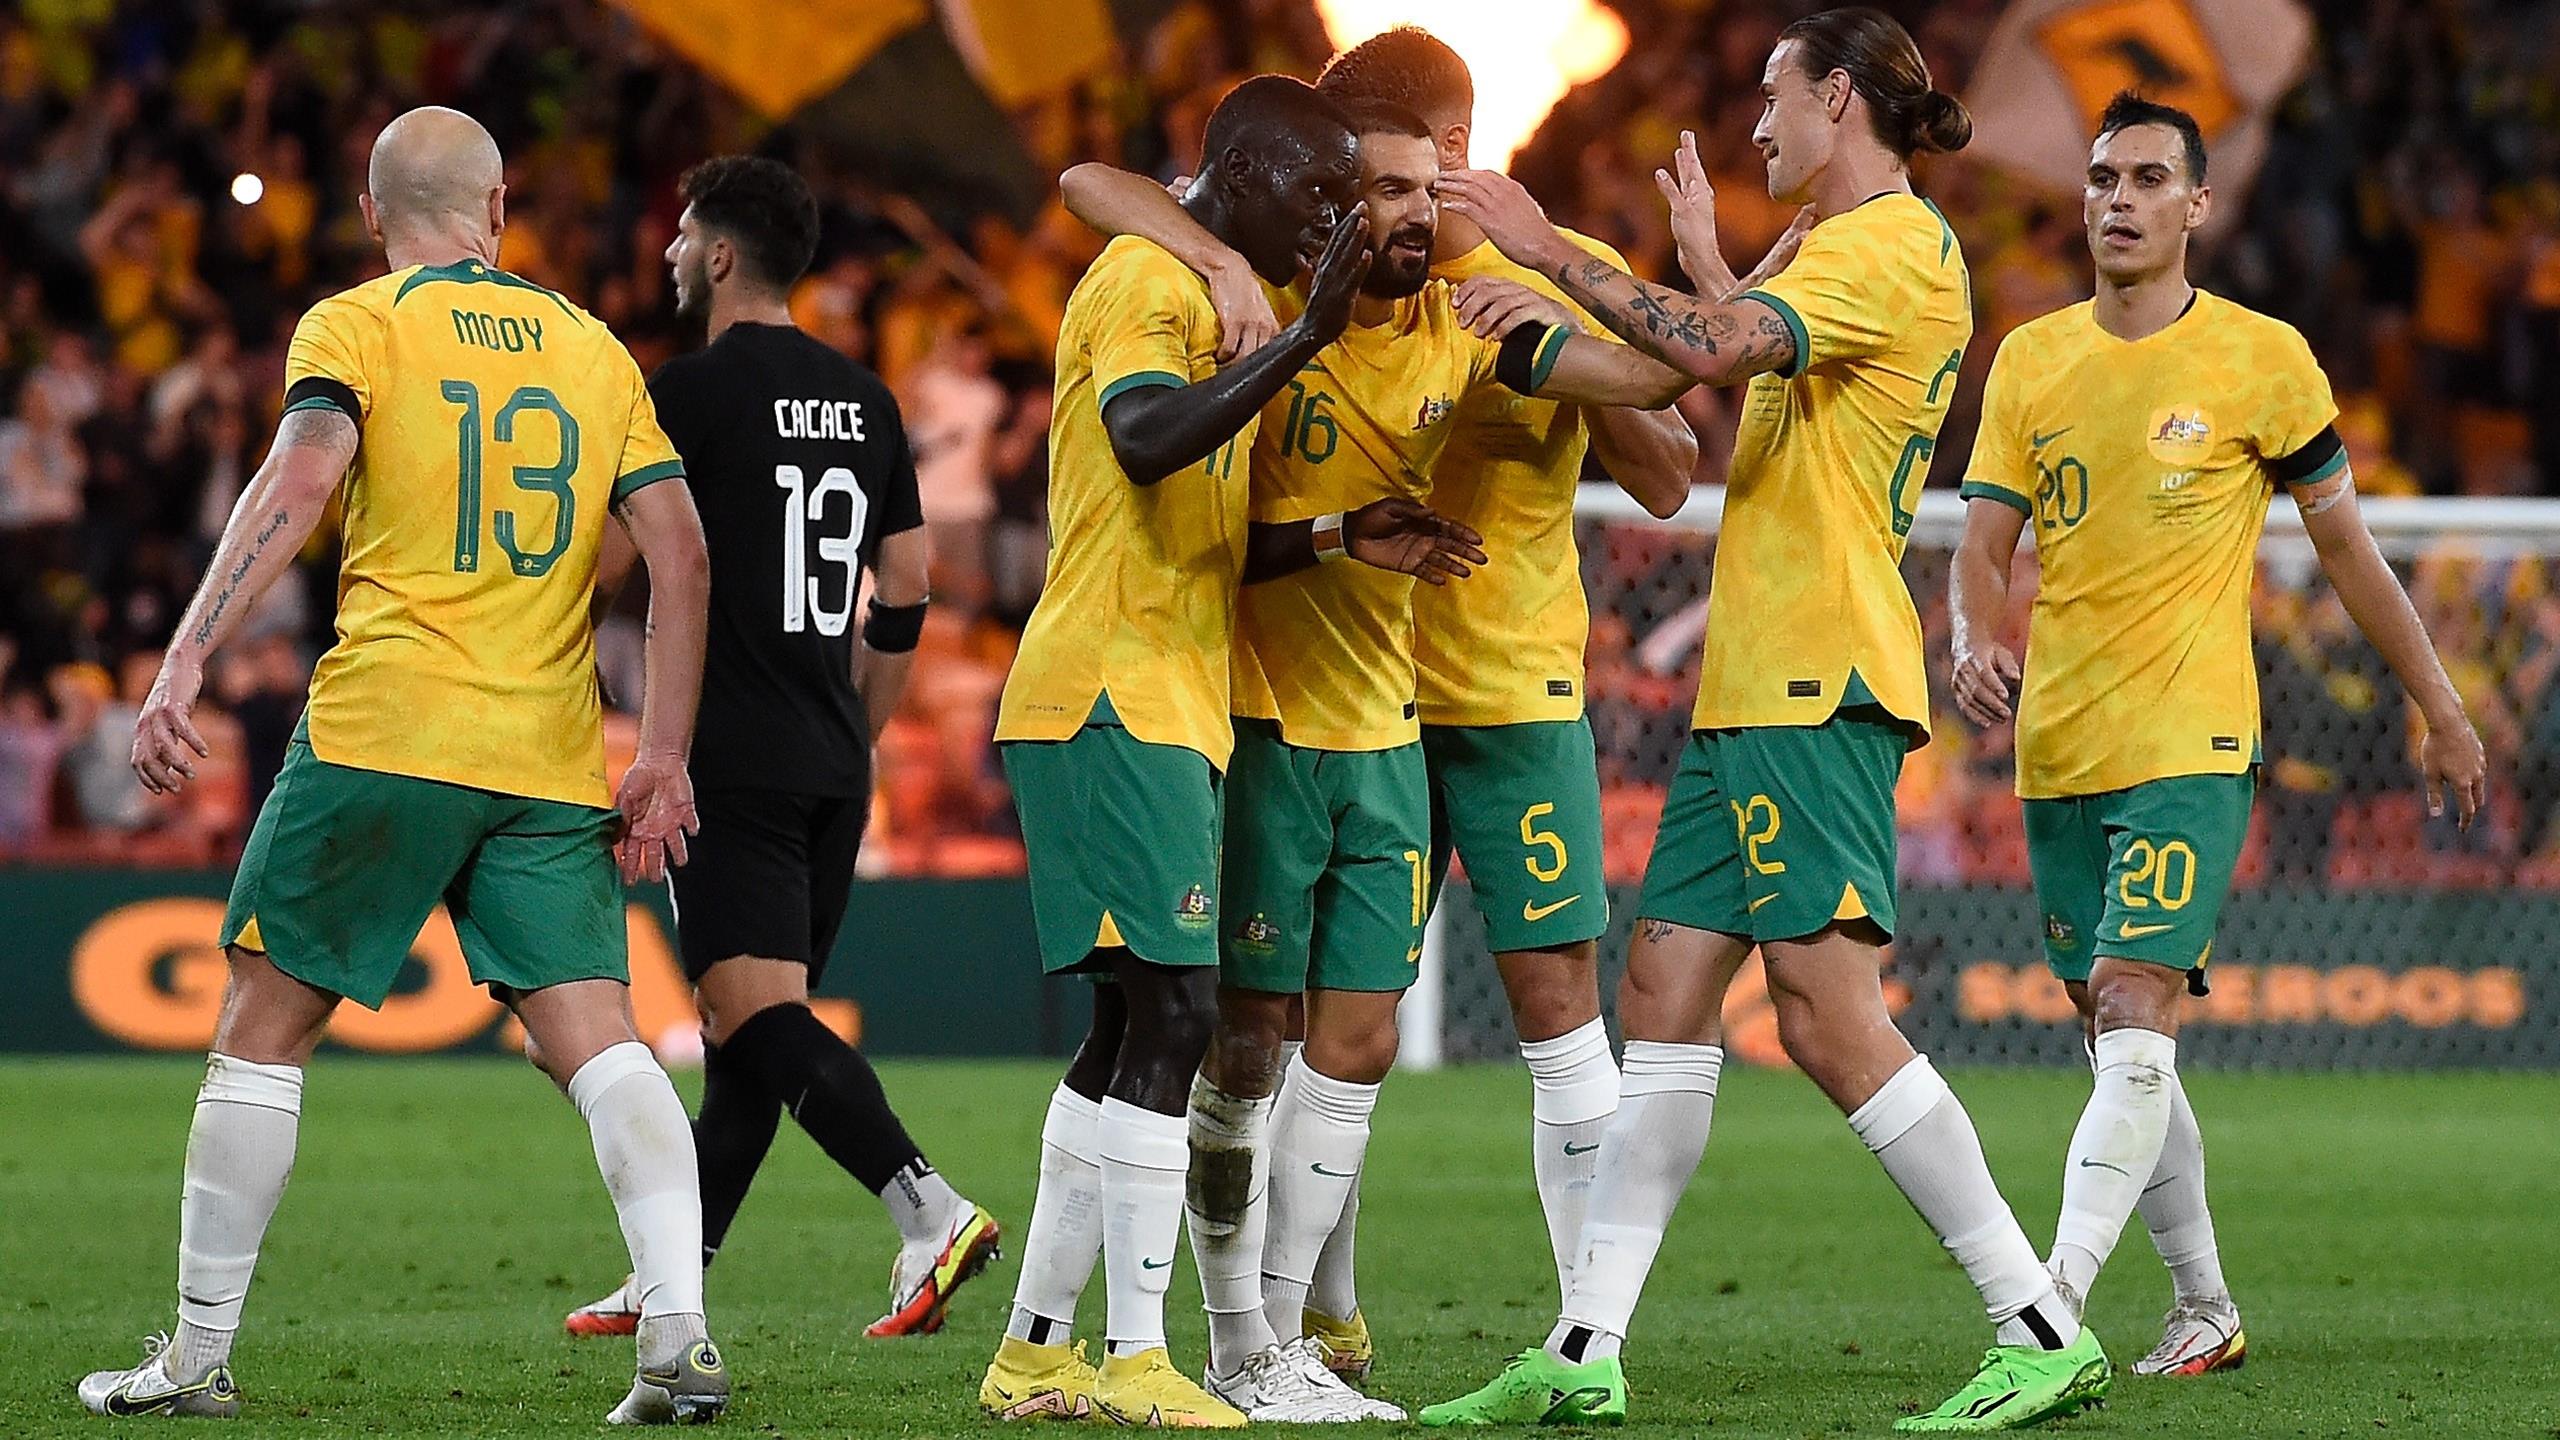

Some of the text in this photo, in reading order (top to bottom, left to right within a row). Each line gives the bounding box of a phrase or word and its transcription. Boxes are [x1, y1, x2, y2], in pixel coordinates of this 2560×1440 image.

[452, 309, 543, 352] MOOY
[774, 399, 866, 443] CACACE
[1280, 378, 1338, 465] 16
[441, 379, 580, 578] 13
[2034, 455, 2088, 529] 20
[775, 464, 869, 637] 13
[1520, 802, 1568, 882] 5
[2120, 838, 2195, 910] 20
[72, 897, 863, 1052] GO
[1957, 961, 2527, 1029] SOEROOS
